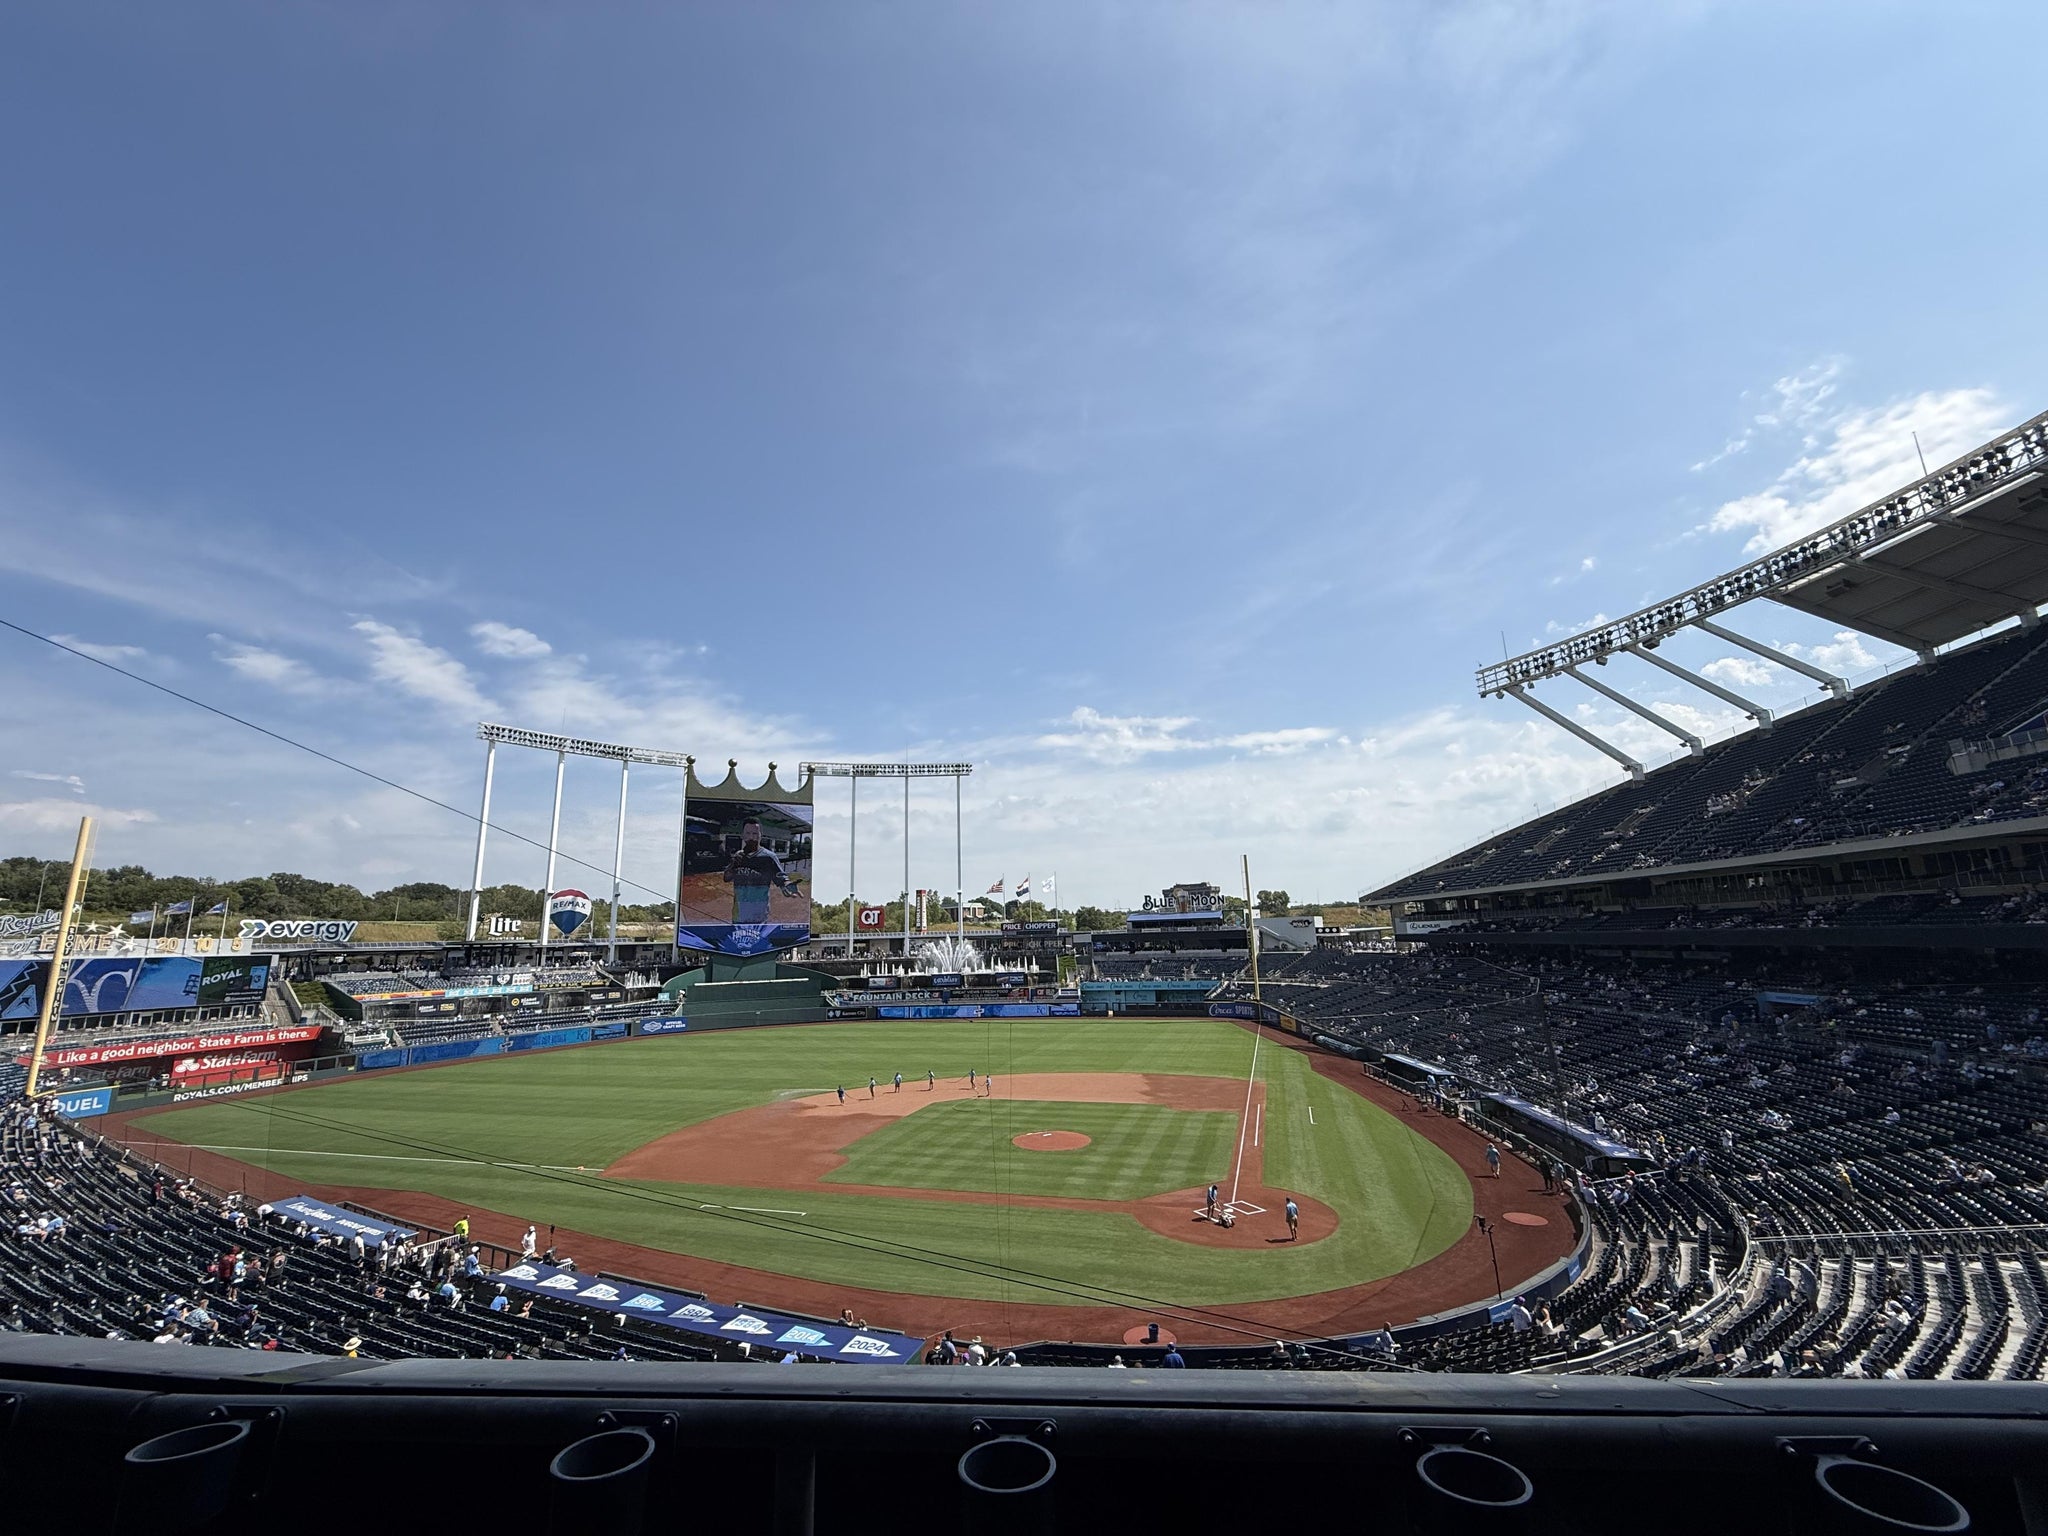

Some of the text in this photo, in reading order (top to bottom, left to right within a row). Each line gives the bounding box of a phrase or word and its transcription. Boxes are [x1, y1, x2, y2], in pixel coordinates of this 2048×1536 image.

[552, 900, 587, 910] RE/MAX
[1143, 895, 1225, 910] BLUE MOON
[861, 910, 880, 925] QT
[269, 921, 358, 942] evergy
[488, 917, 522, 936] Lite
[1025, 922, 1057, 930] CHOPPER
[38, 933, 116, 951] FME
[64, 926, 76, 955] ROOT
[157, 937, 180, 951] 20
[194, 937, 214, 952] 10
[231, 937, 243, 951] 5
[202, 968, 243, 987] ROYAL
[853, 993, 903, 1002] FOUNTAIN
[905, 992, 931, 1000] DECK
[1208, 1003, 1233, 1016] Circa
[57, 1030, 310, 1064] Like a good neighbor, State Farm is there.
[783, 1329, 817, 1342] 2014
[849, 1340, 885, 1353] 2024
